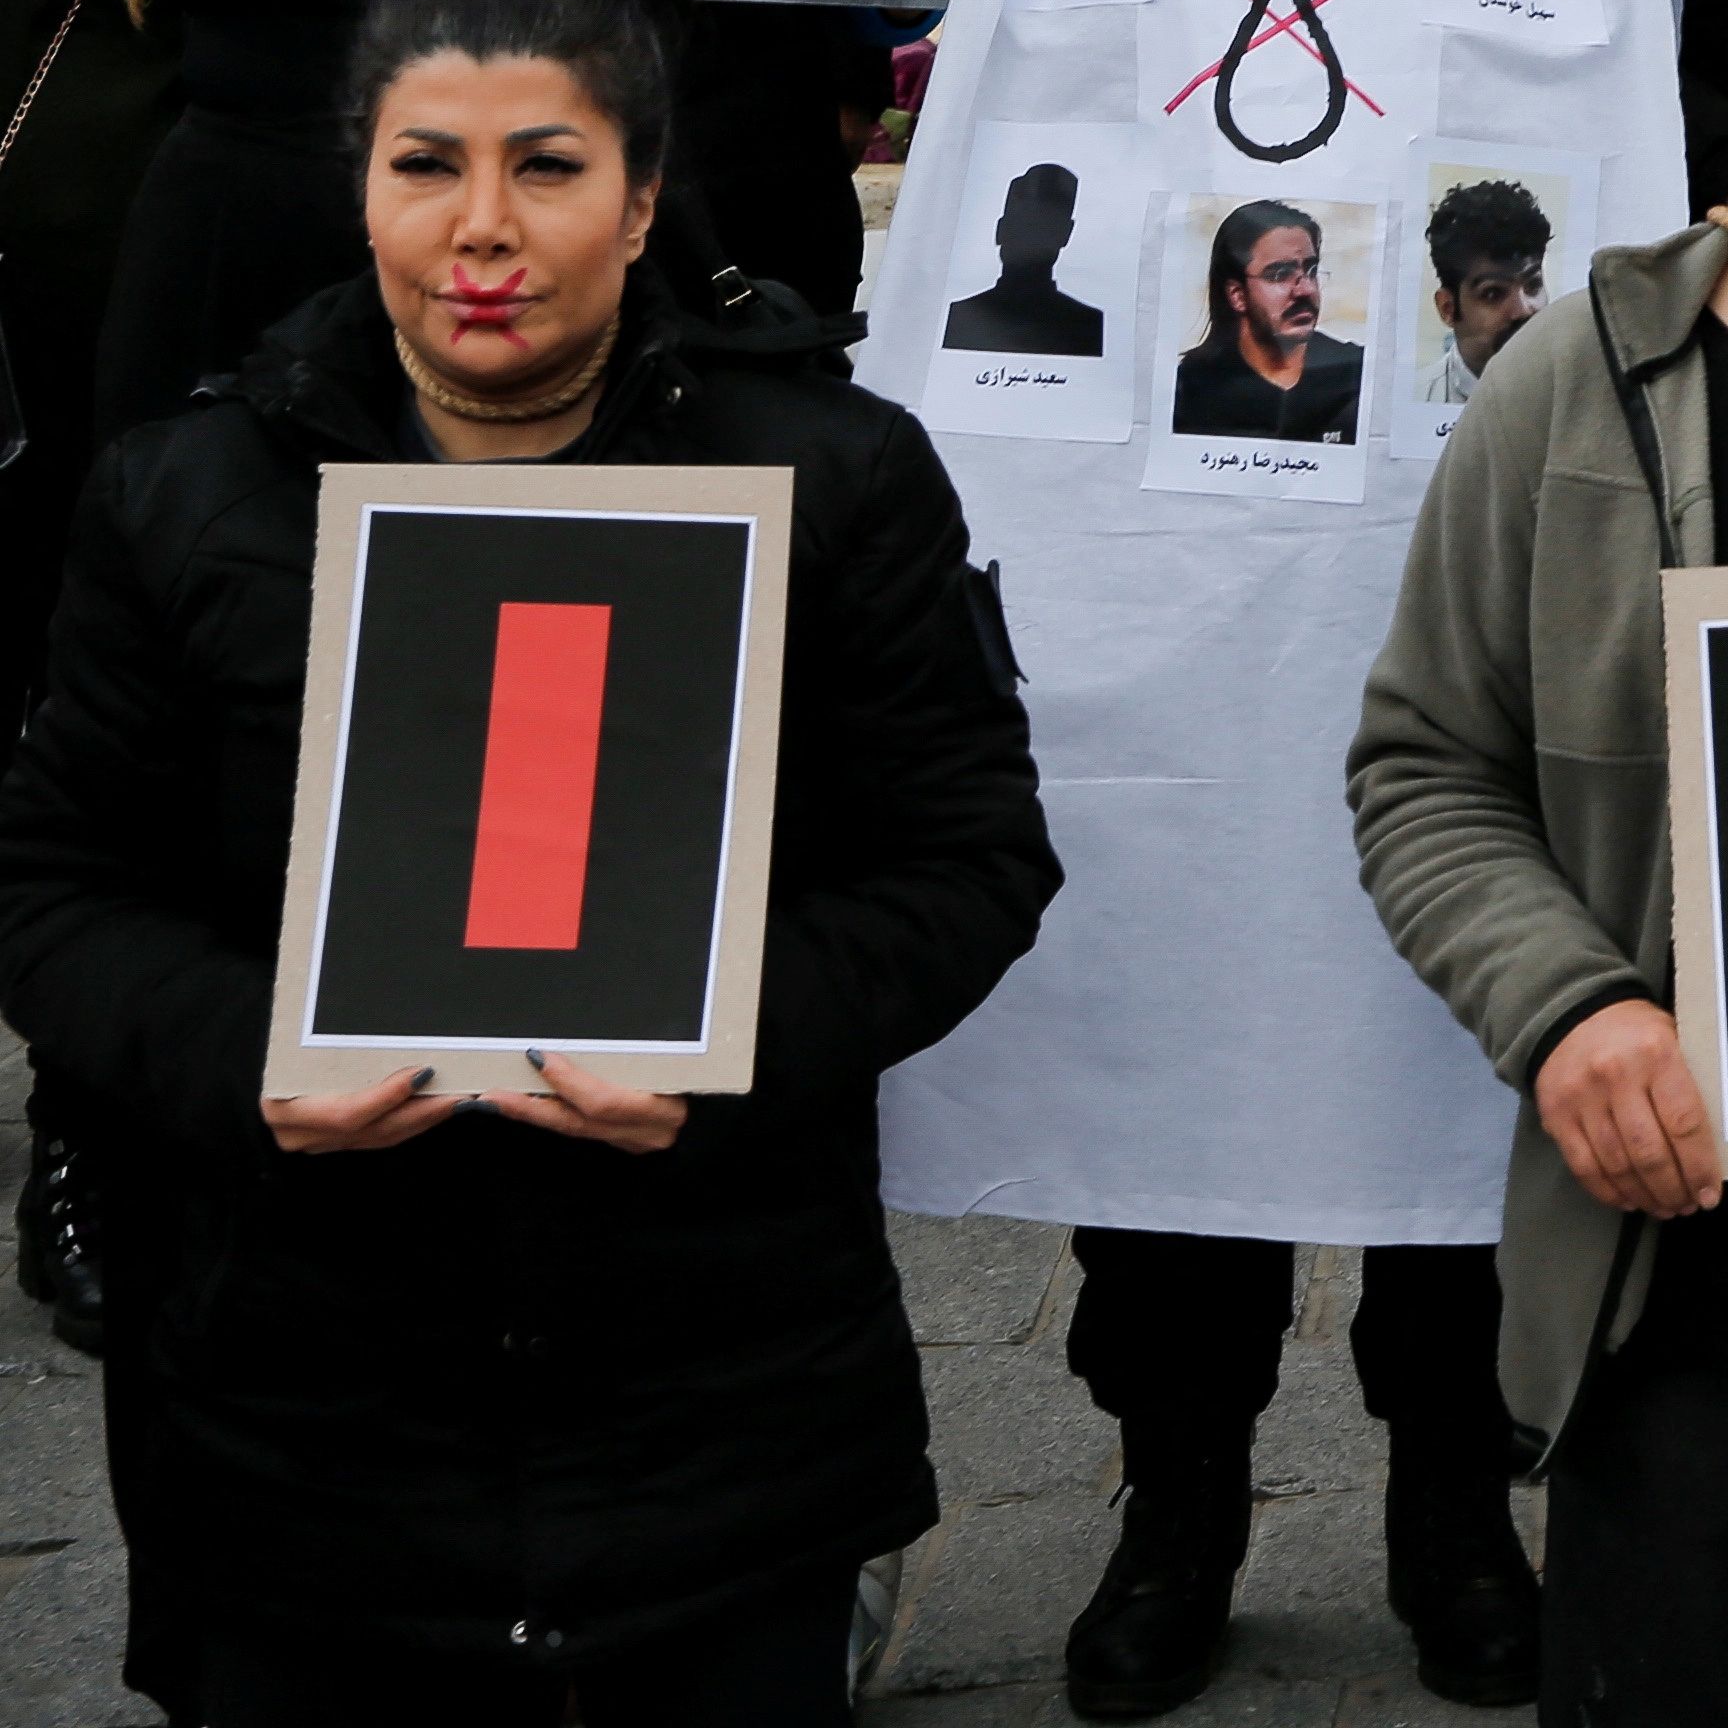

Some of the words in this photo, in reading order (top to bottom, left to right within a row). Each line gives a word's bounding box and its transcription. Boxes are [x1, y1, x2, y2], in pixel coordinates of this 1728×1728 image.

[975, 365, 1030, 387] شیرازی
[1033, 371, 1067, 388] سعید
[1201, 451, 1248, 472] رهنورد
[1252, 451, 1319, 475] مجیدرضا
[464, 603, 612, 950] I
